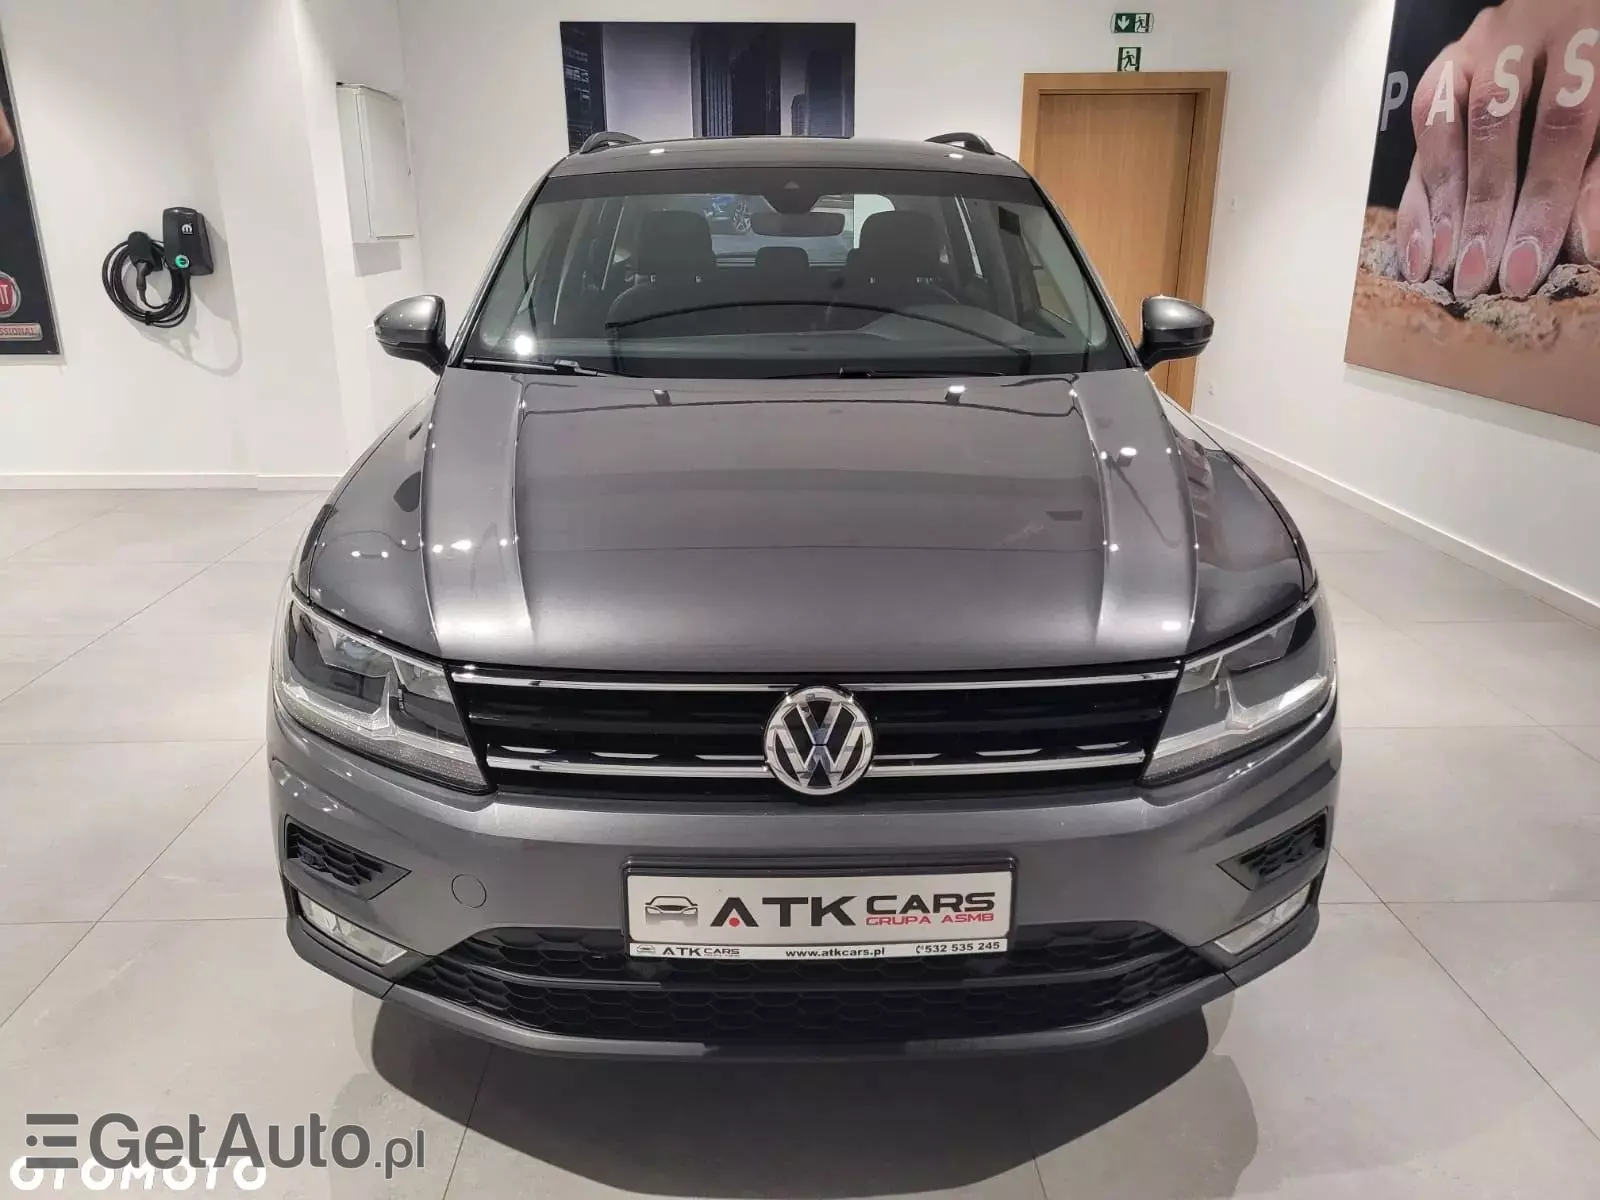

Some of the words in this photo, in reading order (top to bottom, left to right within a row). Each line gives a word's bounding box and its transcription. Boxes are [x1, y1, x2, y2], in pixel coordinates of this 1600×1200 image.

[1380, 28, 1600, 131] PASS
[710, 897, 857, 927] ATK
[866, 892, 995, 915] CARS
[866, 915, 932, 926] GRUPA
[941, 913, 994, 924] ASMB
[662, 947, 702, 957] ATK
[785, 947, 885, 957] www.atkcars.pl
[924, 944, 947, 954] 532
[951, 943, 974, 952] 535
[978, 941, 1000, 950] 245
